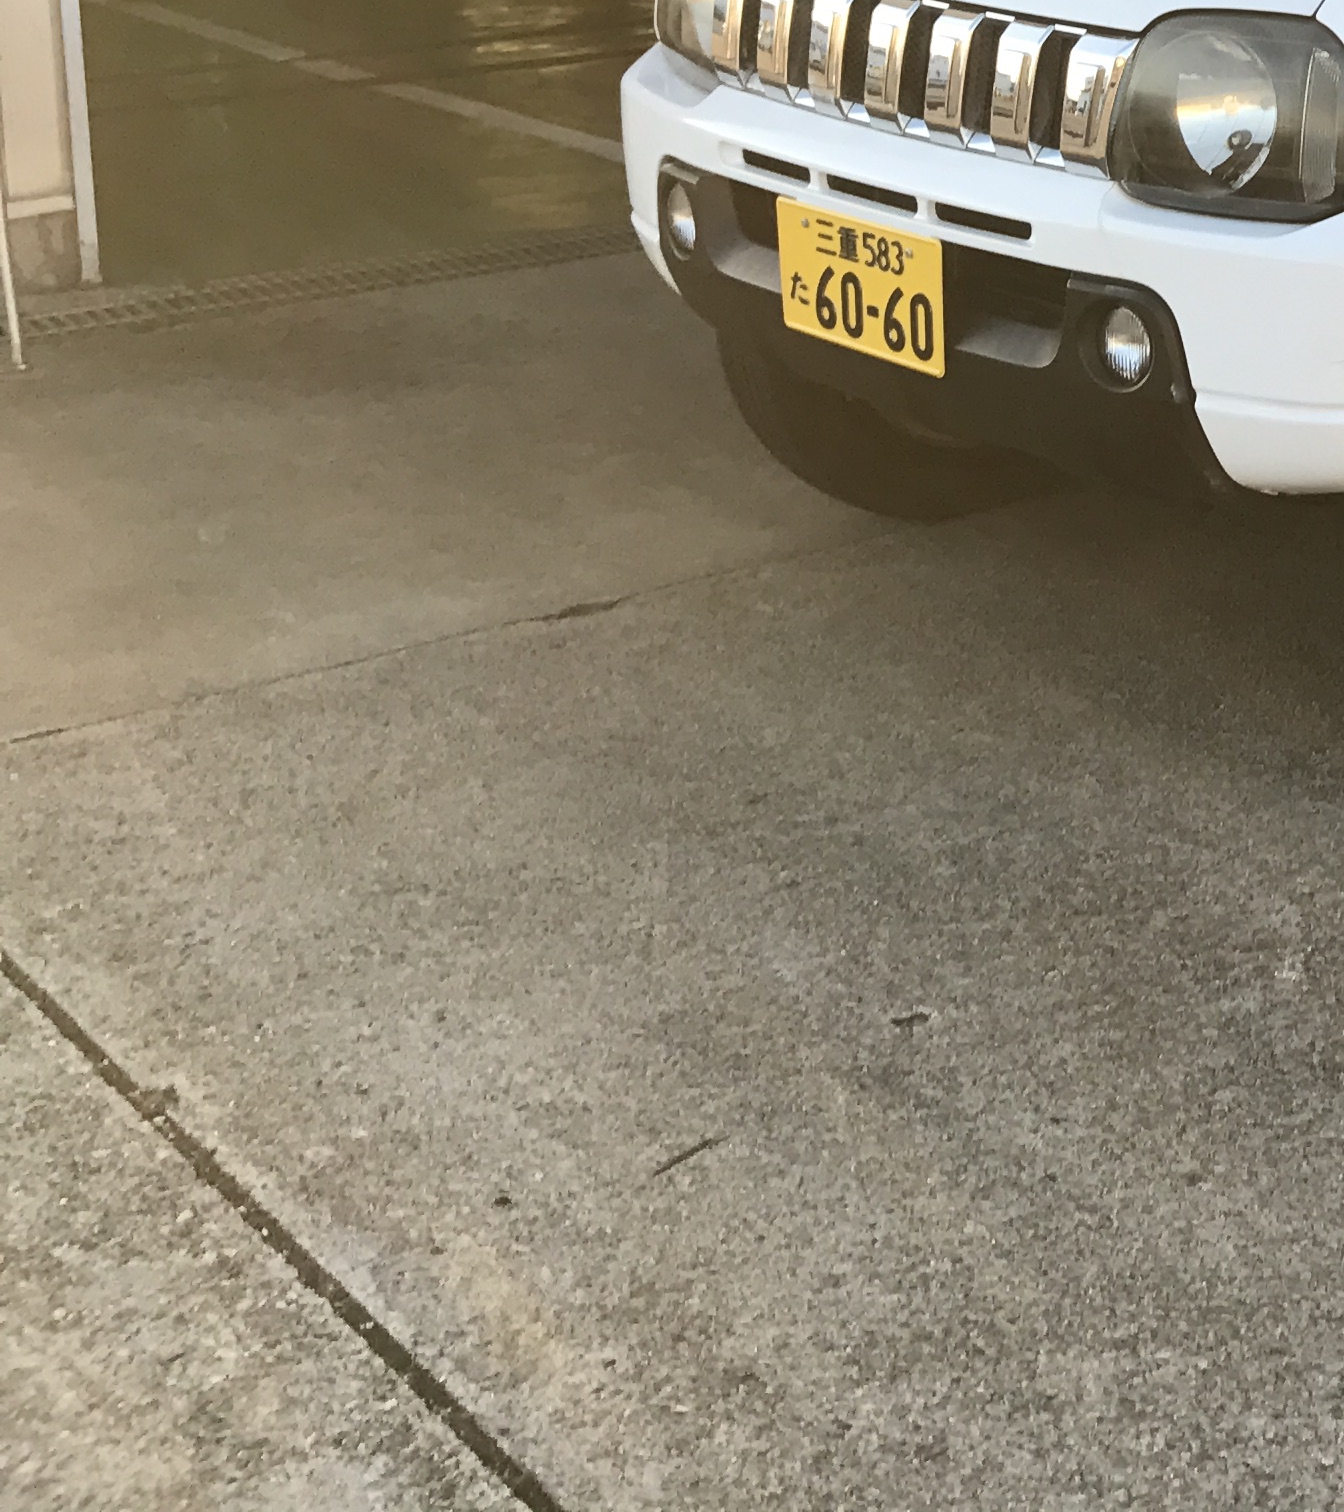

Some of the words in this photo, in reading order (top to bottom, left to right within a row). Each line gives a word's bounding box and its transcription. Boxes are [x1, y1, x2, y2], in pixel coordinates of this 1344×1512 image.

[815, 218, 860, 264] 三重
[862, 232, 905, 275] 583
[790, 271, 811, 306] た
[815, 265, 935, 362] 60-60
